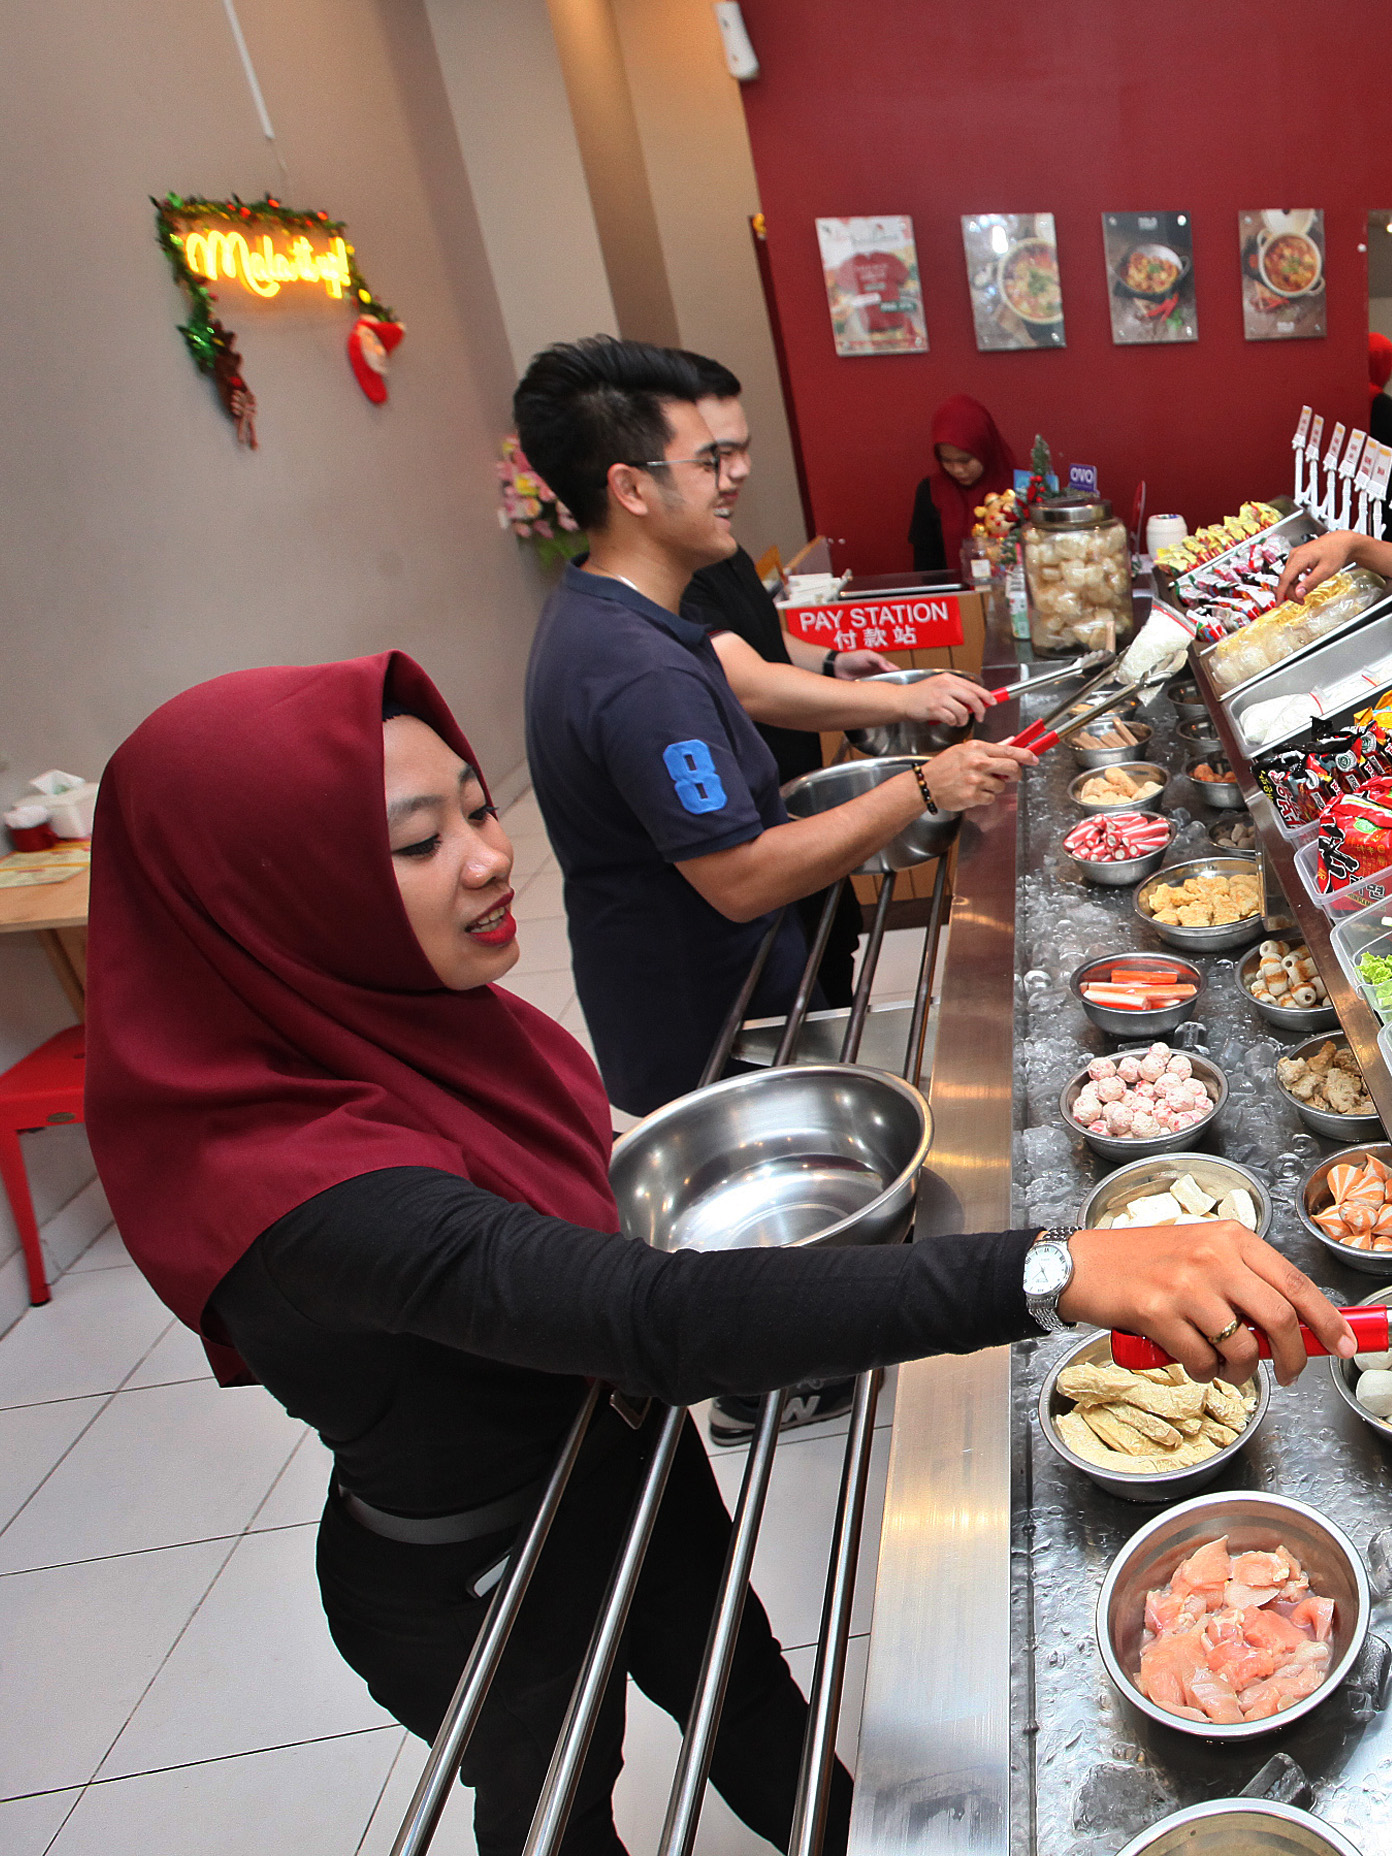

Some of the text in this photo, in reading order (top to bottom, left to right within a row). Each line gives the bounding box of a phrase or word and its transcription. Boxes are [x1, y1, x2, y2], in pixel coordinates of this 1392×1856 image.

[1070, 467, 1093, 484] OVO
[800, 602, 949, 632] PAY STATION
[833, 624, 917, 650] 付款站
[663, 739, 727, 814] 8
